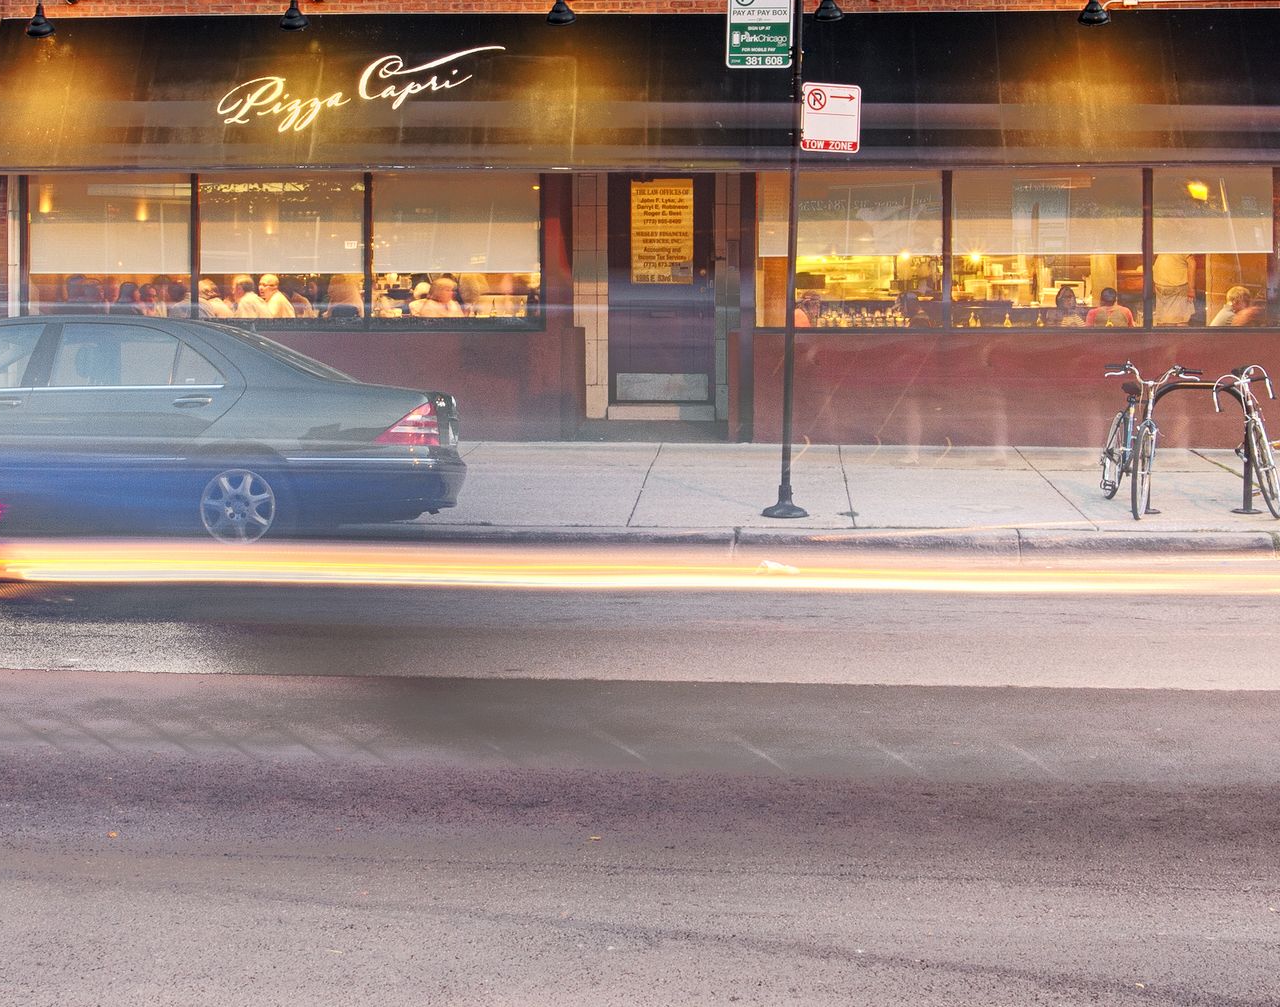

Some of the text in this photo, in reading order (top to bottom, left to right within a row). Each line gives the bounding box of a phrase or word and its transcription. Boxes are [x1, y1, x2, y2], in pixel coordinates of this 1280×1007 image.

[741, 32, 787, 44] ParkChicago
[745, 57, 762, 65] 381
[765, 56, 783, 65] 608
[217, 45, 506, 133] Pizza Capri
[806, 140, 854, 150] TOW ZONE
